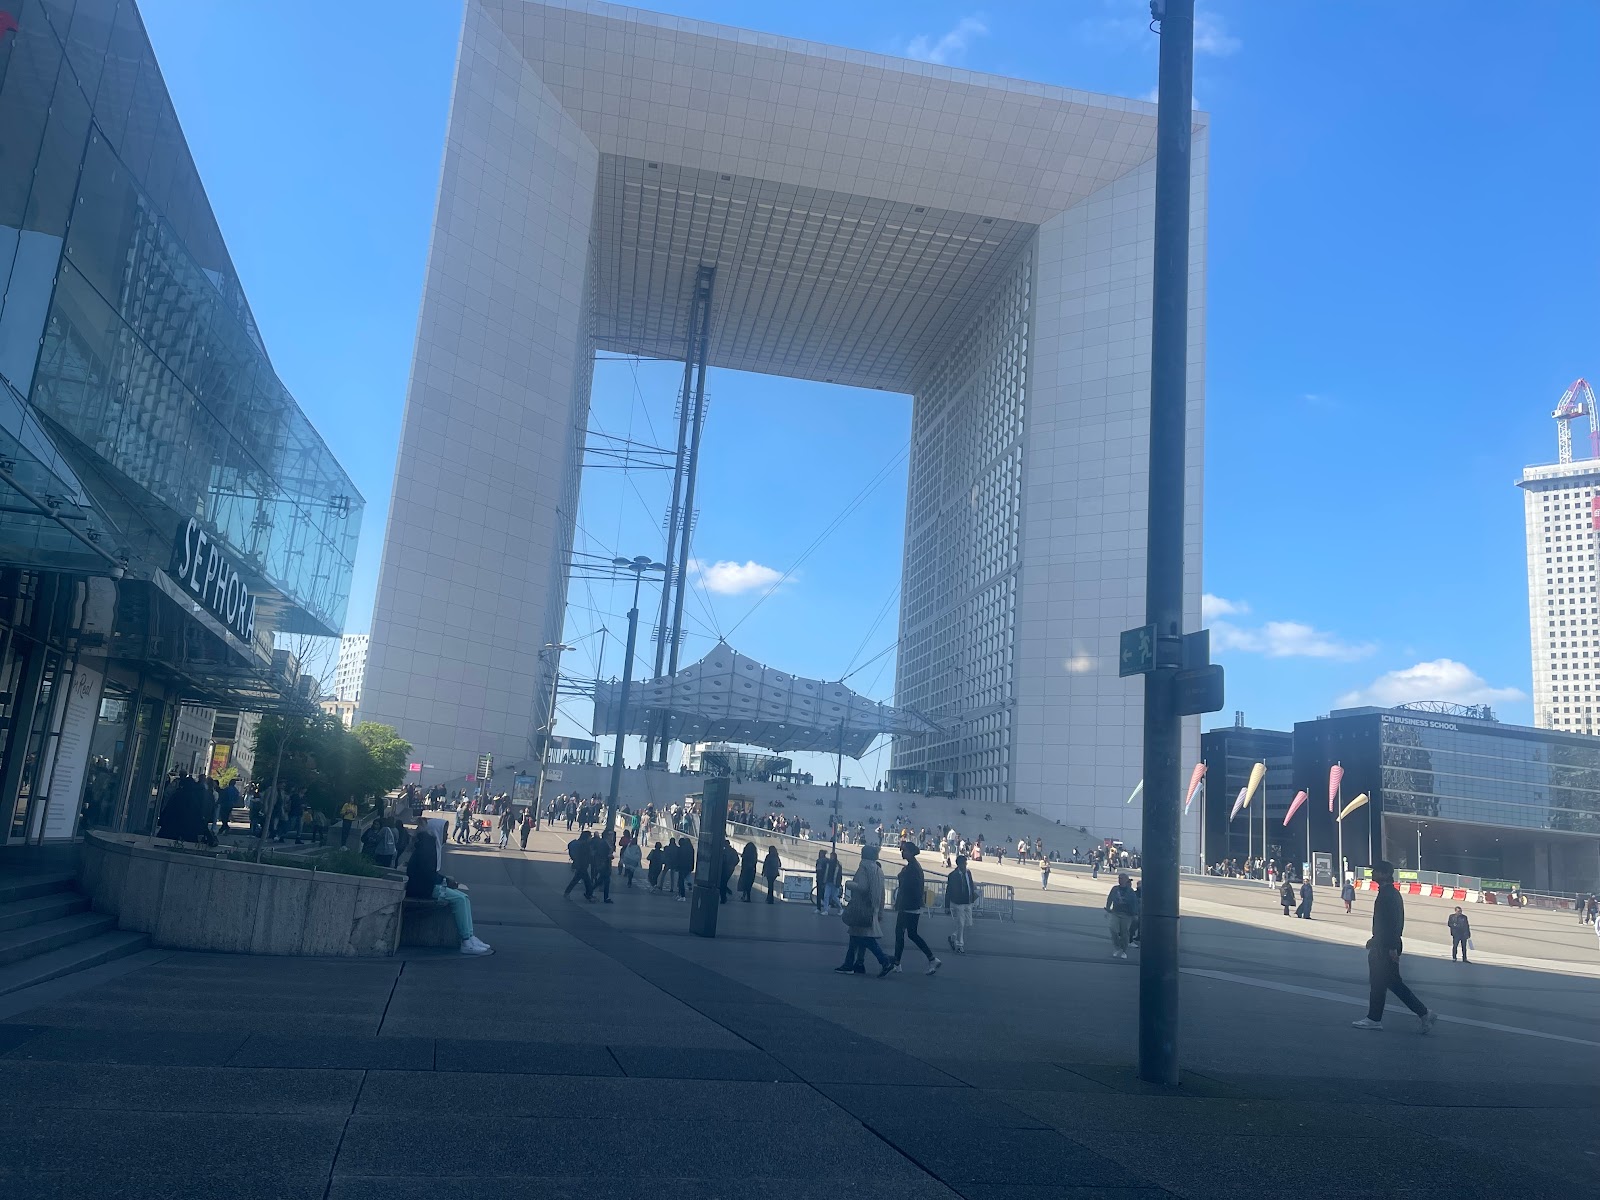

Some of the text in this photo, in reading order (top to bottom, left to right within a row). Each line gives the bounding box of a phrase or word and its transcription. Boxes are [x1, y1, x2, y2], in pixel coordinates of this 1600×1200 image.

[178, 516, 256, 645] SEPHORA
[1381, 715, 1459, 731] ICN BUSINESS SCHOOL
